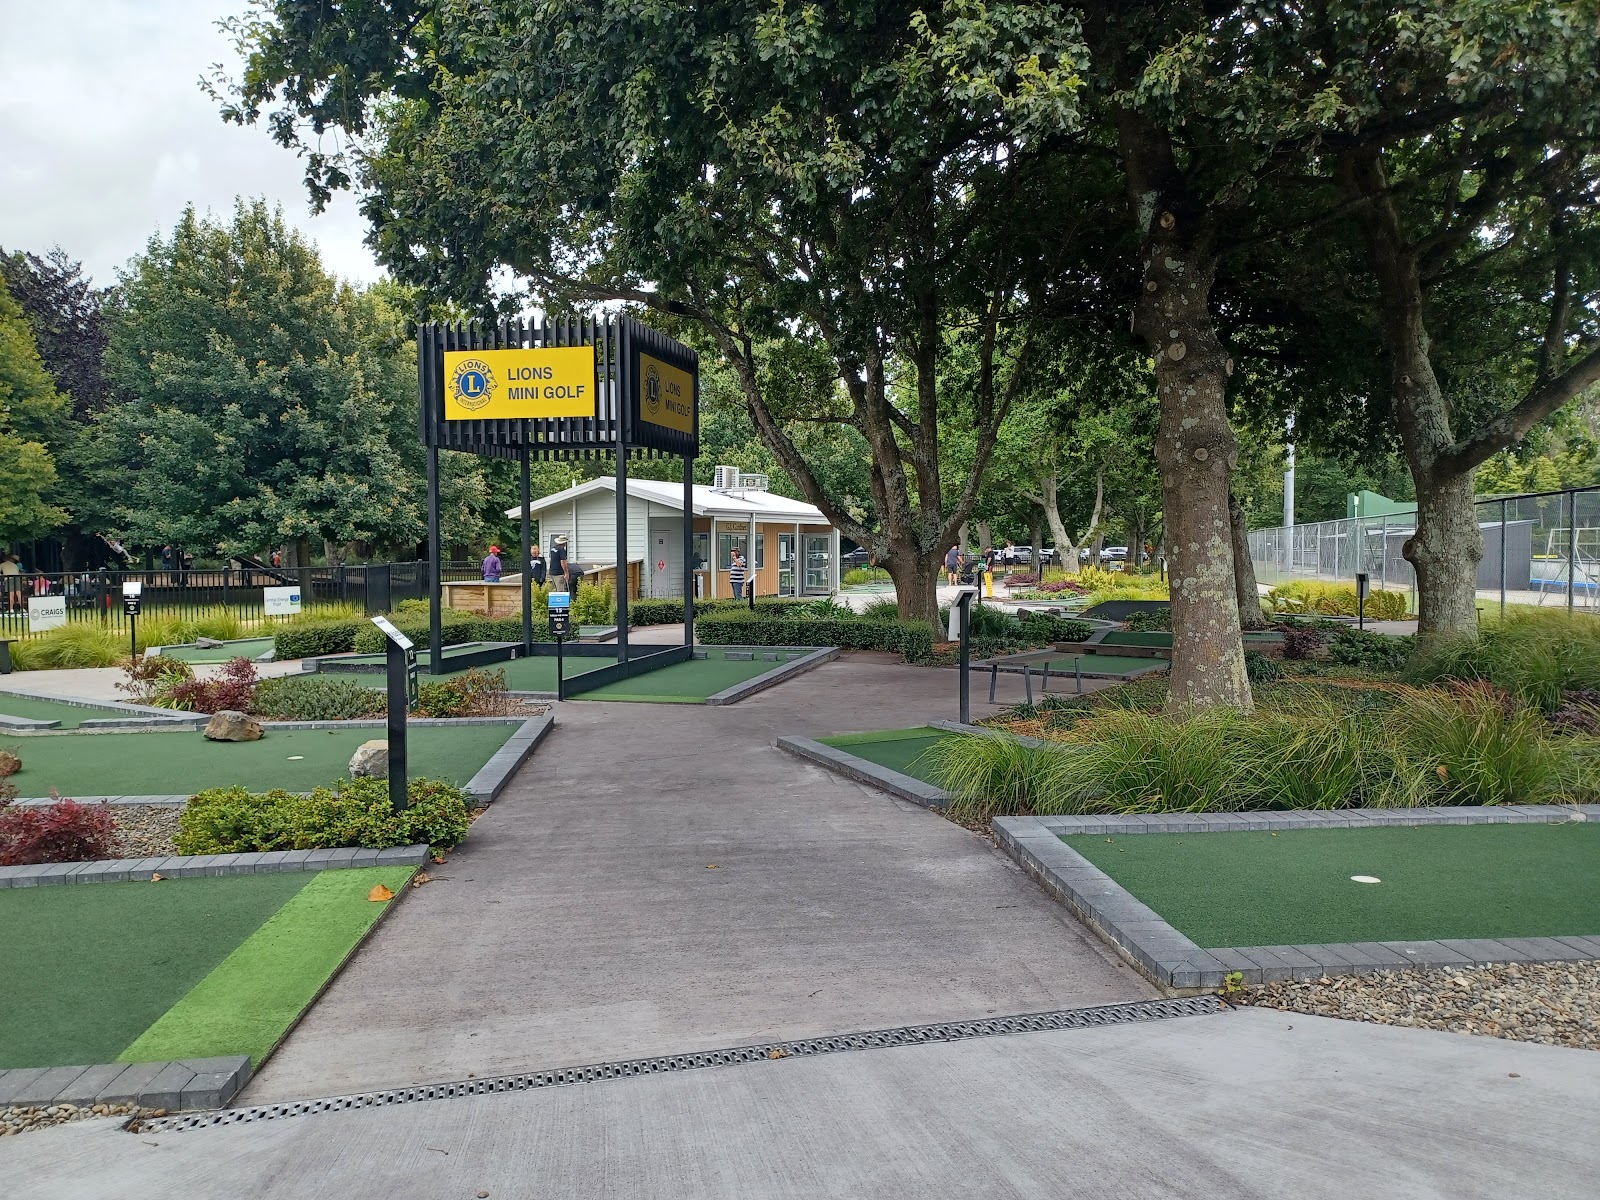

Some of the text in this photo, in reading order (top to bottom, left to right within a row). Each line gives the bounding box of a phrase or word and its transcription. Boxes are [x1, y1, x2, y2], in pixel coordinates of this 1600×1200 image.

[458, 361, 487, 373] LIONS
[507, 366, 553, 381] LIONS
[467, 375, 480, 393] L
[665, 380, 681, 397] LIONS
[508, 385, 585, 400] MINI GOLF
[665, 399, 677, 413] MINI
[676, 403, 691, 417] GOLF
[41, 608, 64, 616] CRAIGS
